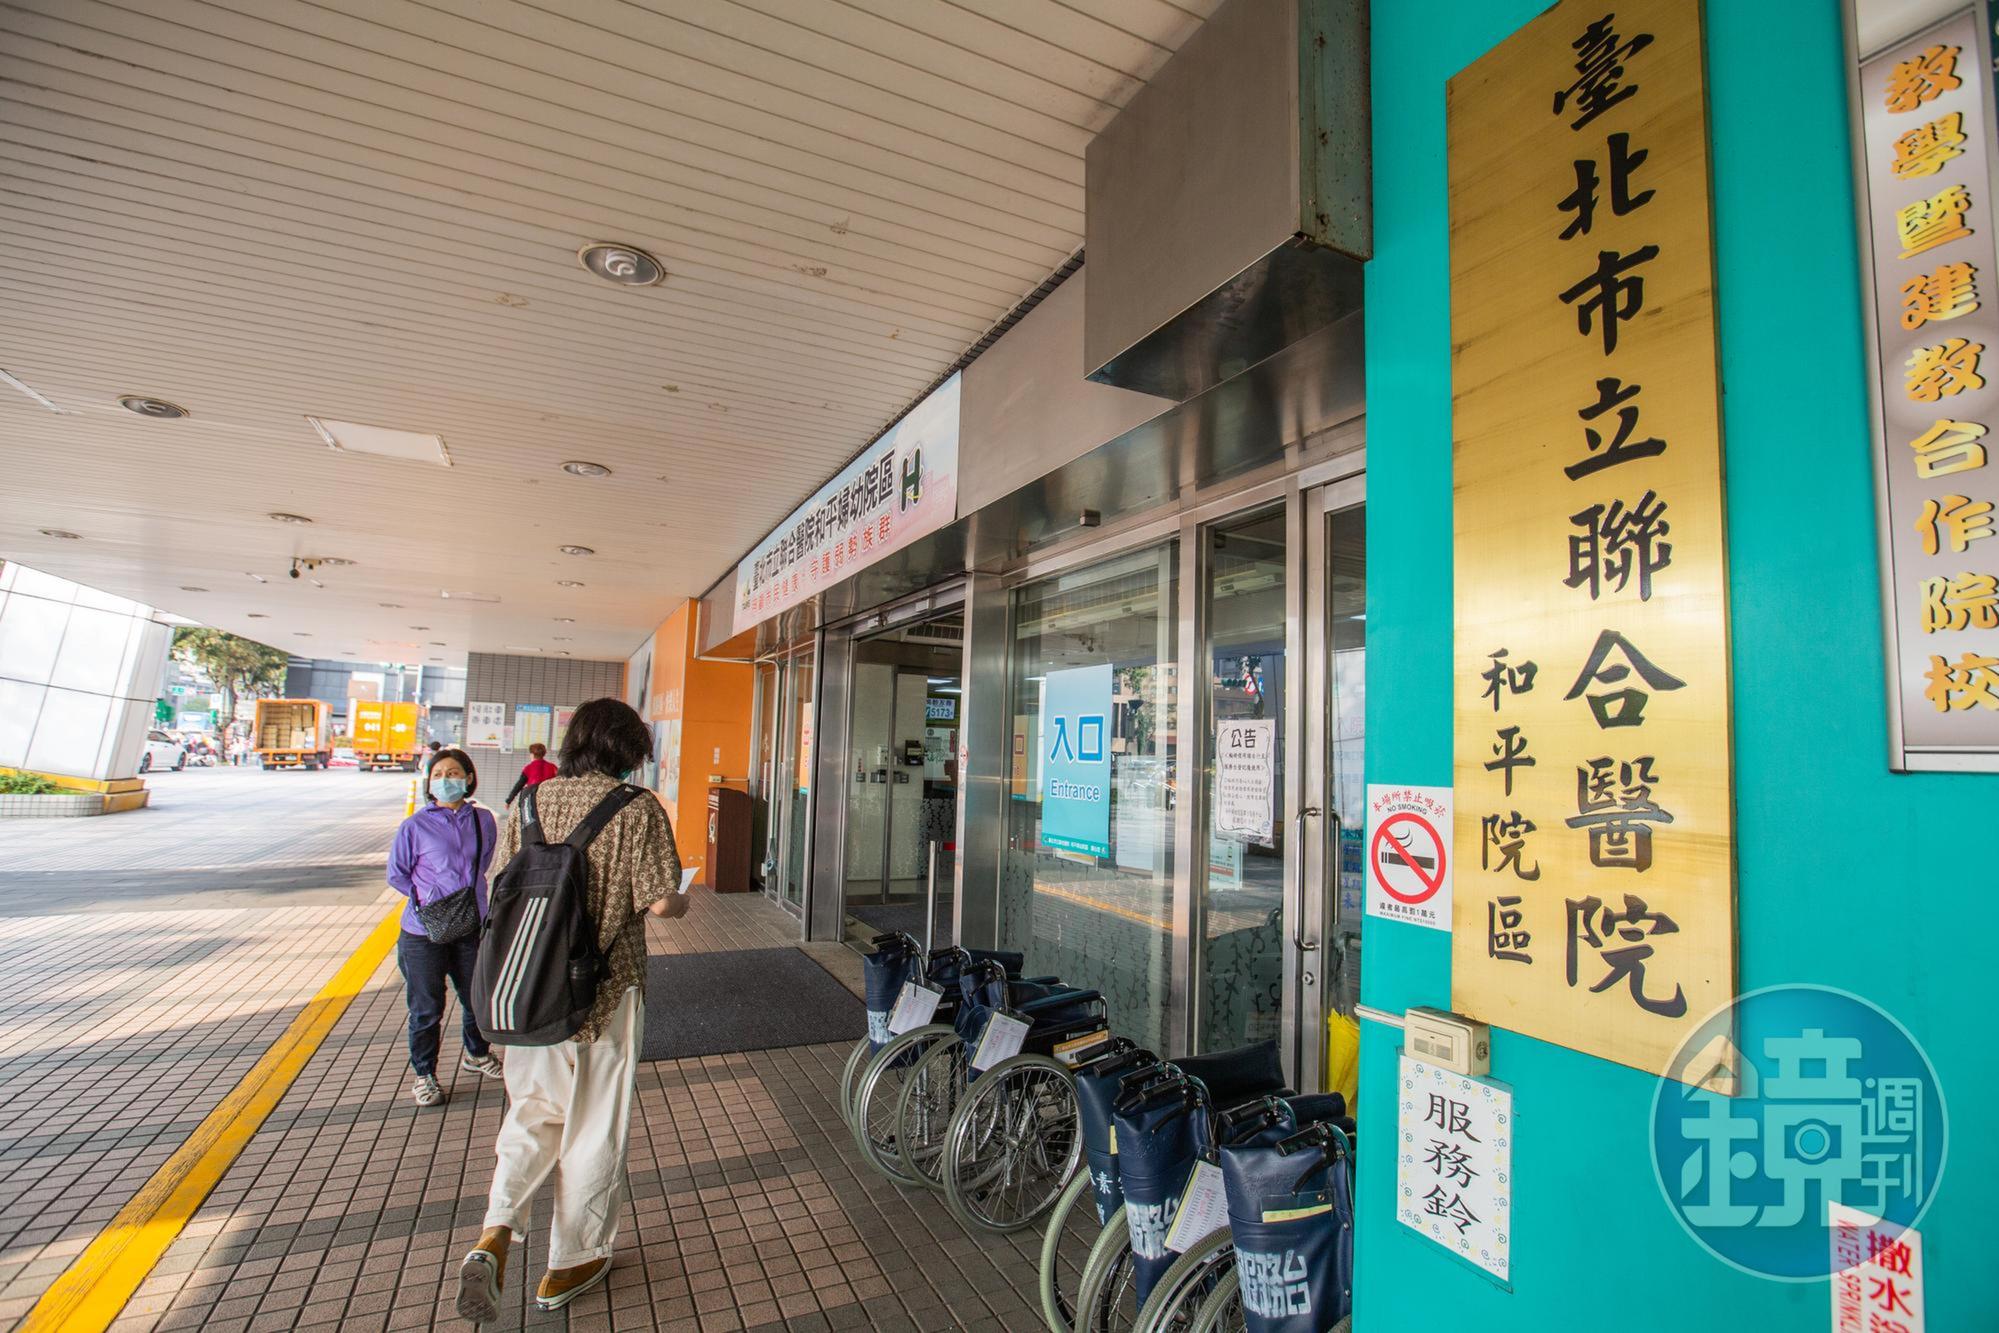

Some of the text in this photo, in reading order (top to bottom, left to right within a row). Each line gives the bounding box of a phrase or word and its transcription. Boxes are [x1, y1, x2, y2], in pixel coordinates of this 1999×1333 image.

[1884, 45, 1999, 713] 教學暨建教合作院校
[1553, 14, 1688, 1018] 臺北市立聯合醫院
[1050, 715, 1104, 763] 入口
[1231, 728, 1256, 749] 公告
[1051, 779, 1100, 800] Entrance
[1387, 803, 1428, 815] NO SMOKING
[1481, 649, 1540, 965] 和平院區
[1423, 1093, 1482, 1235] 服務鈴
